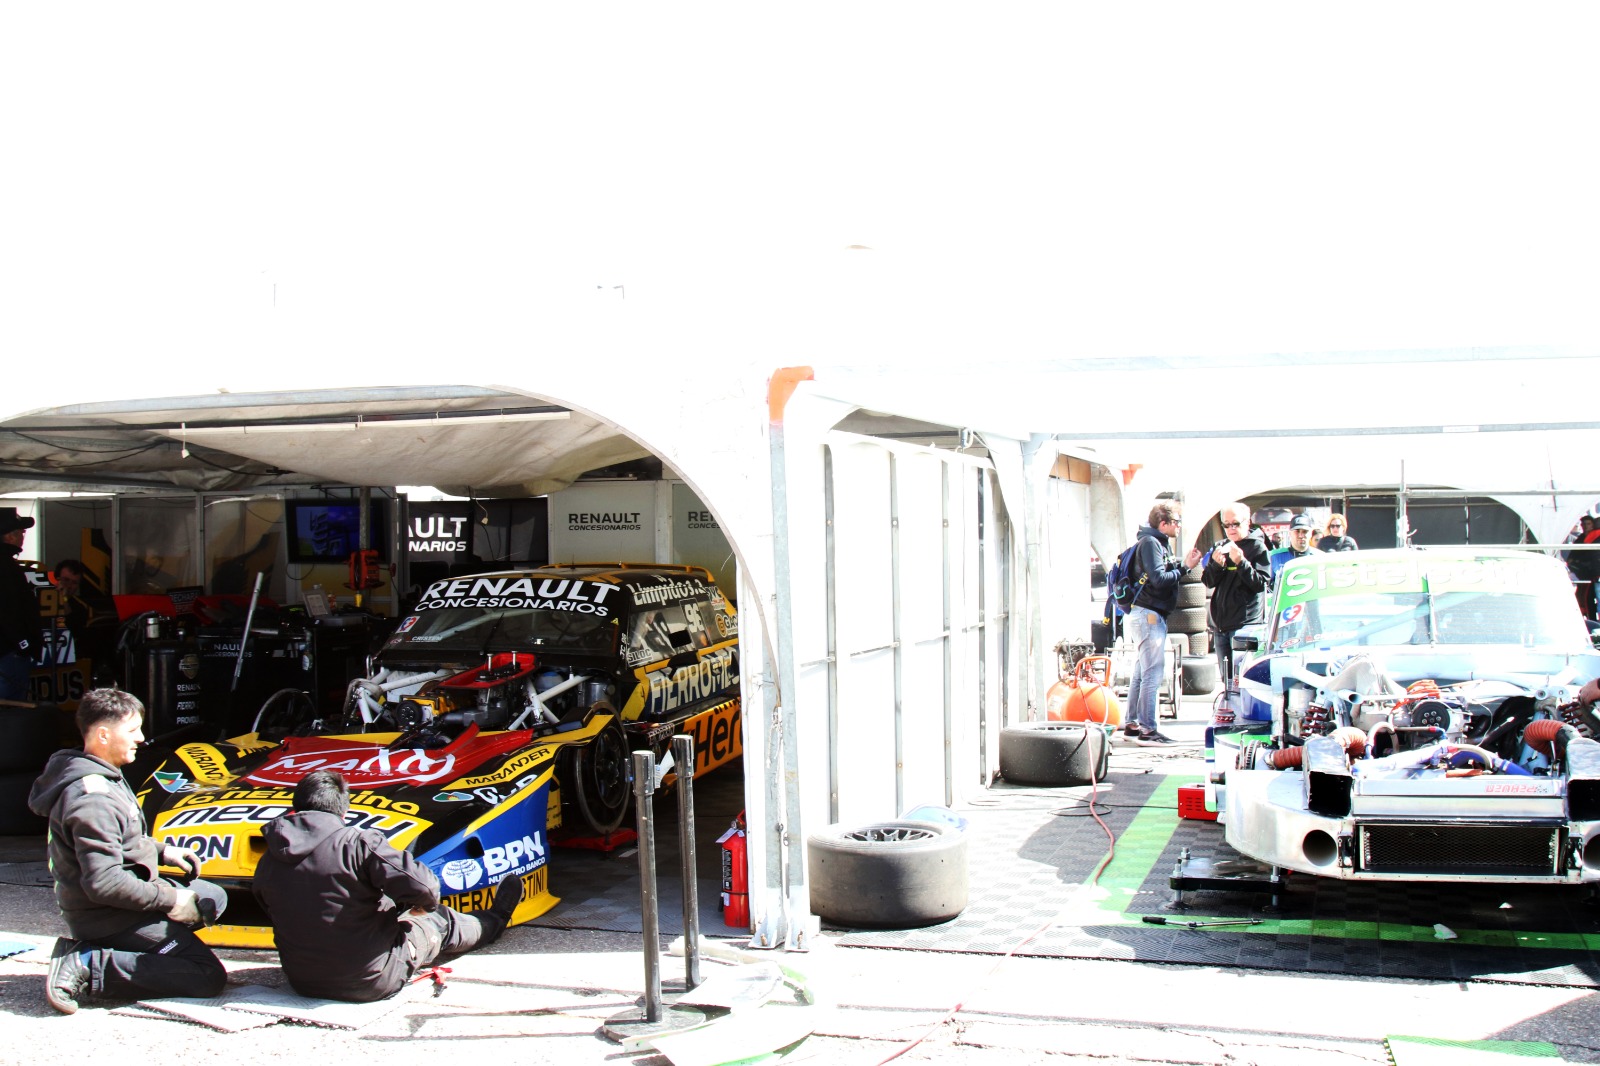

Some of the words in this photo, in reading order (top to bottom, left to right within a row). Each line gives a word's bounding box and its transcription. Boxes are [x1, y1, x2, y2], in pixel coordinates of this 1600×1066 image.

[568, 513, 641, 524] RENAULT
[419, 578, 621, 604] RENAULT
[414, 597, 609, 617] CONCESIONARIOS
[684, 603, 705, 633] 96
[695, 705, 743, 767] Her
[465, 748, 551, 785] MARANDER
[482, 830, 545, 876] BPN
[526, 856, 546, 872] BANCO
